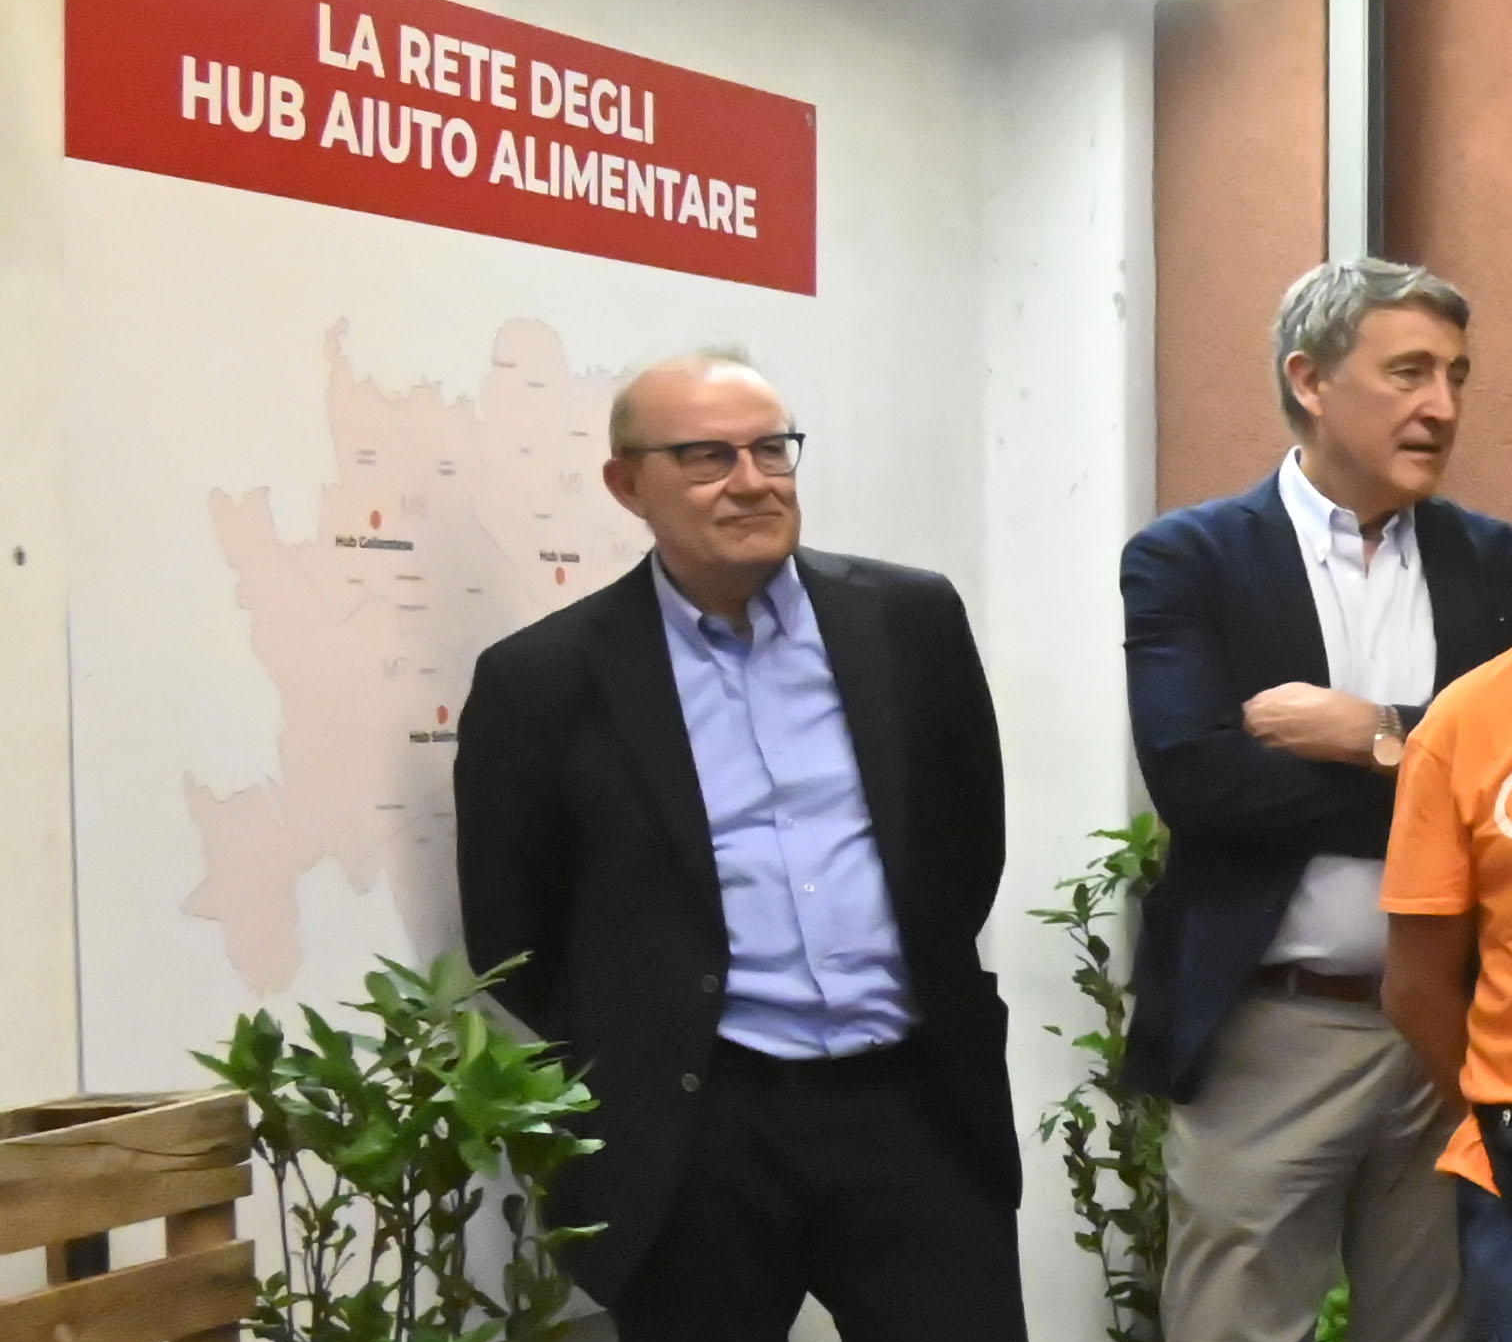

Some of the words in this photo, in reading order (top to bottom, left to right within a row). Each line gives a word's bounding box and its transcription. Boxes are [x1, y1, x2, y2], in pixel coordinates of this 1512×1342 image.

[181, 55, 306, 142] HUB
[319, 89, 478, 179] AIUTO
[488, 129, 759, 240] ALIMENTARE
[318, 1, 386, 79] LA
[399, 24, 517, 111] RETE
[530, 59, 655, 146] DEGLI
